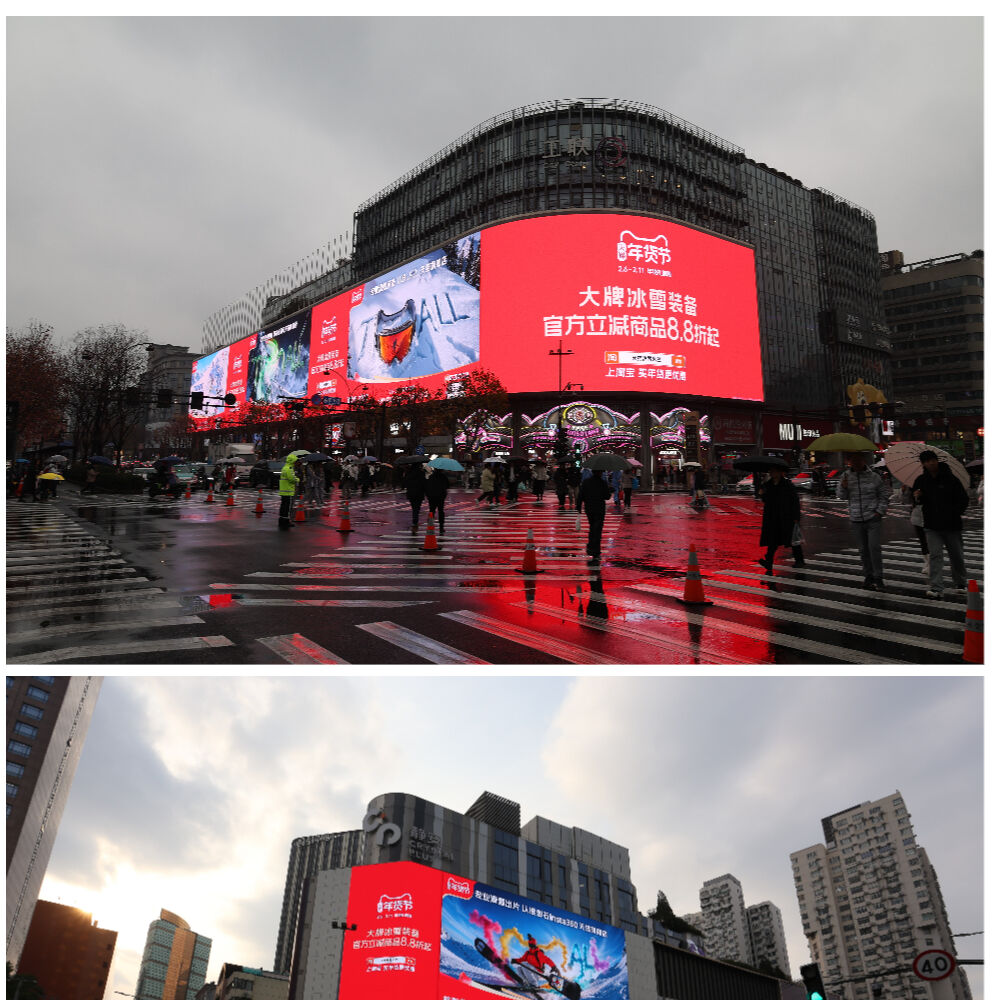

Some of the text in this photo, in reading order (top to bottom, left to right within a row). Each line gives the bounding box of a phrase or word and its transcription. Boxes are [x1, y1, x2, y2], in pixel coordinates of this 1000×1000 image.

[627, 243, 671, 265] 年货节
[578, 285, 698, 317] 大牌冰雪装备
[543, 314, 721, 348] 官方立减商品8.8折起
[366, 927, 420, 939] 大牌冰雪装备
[352, 937, 433, 952] 官方立减商品8.8折起
[921, 956, 949, 974] 40
